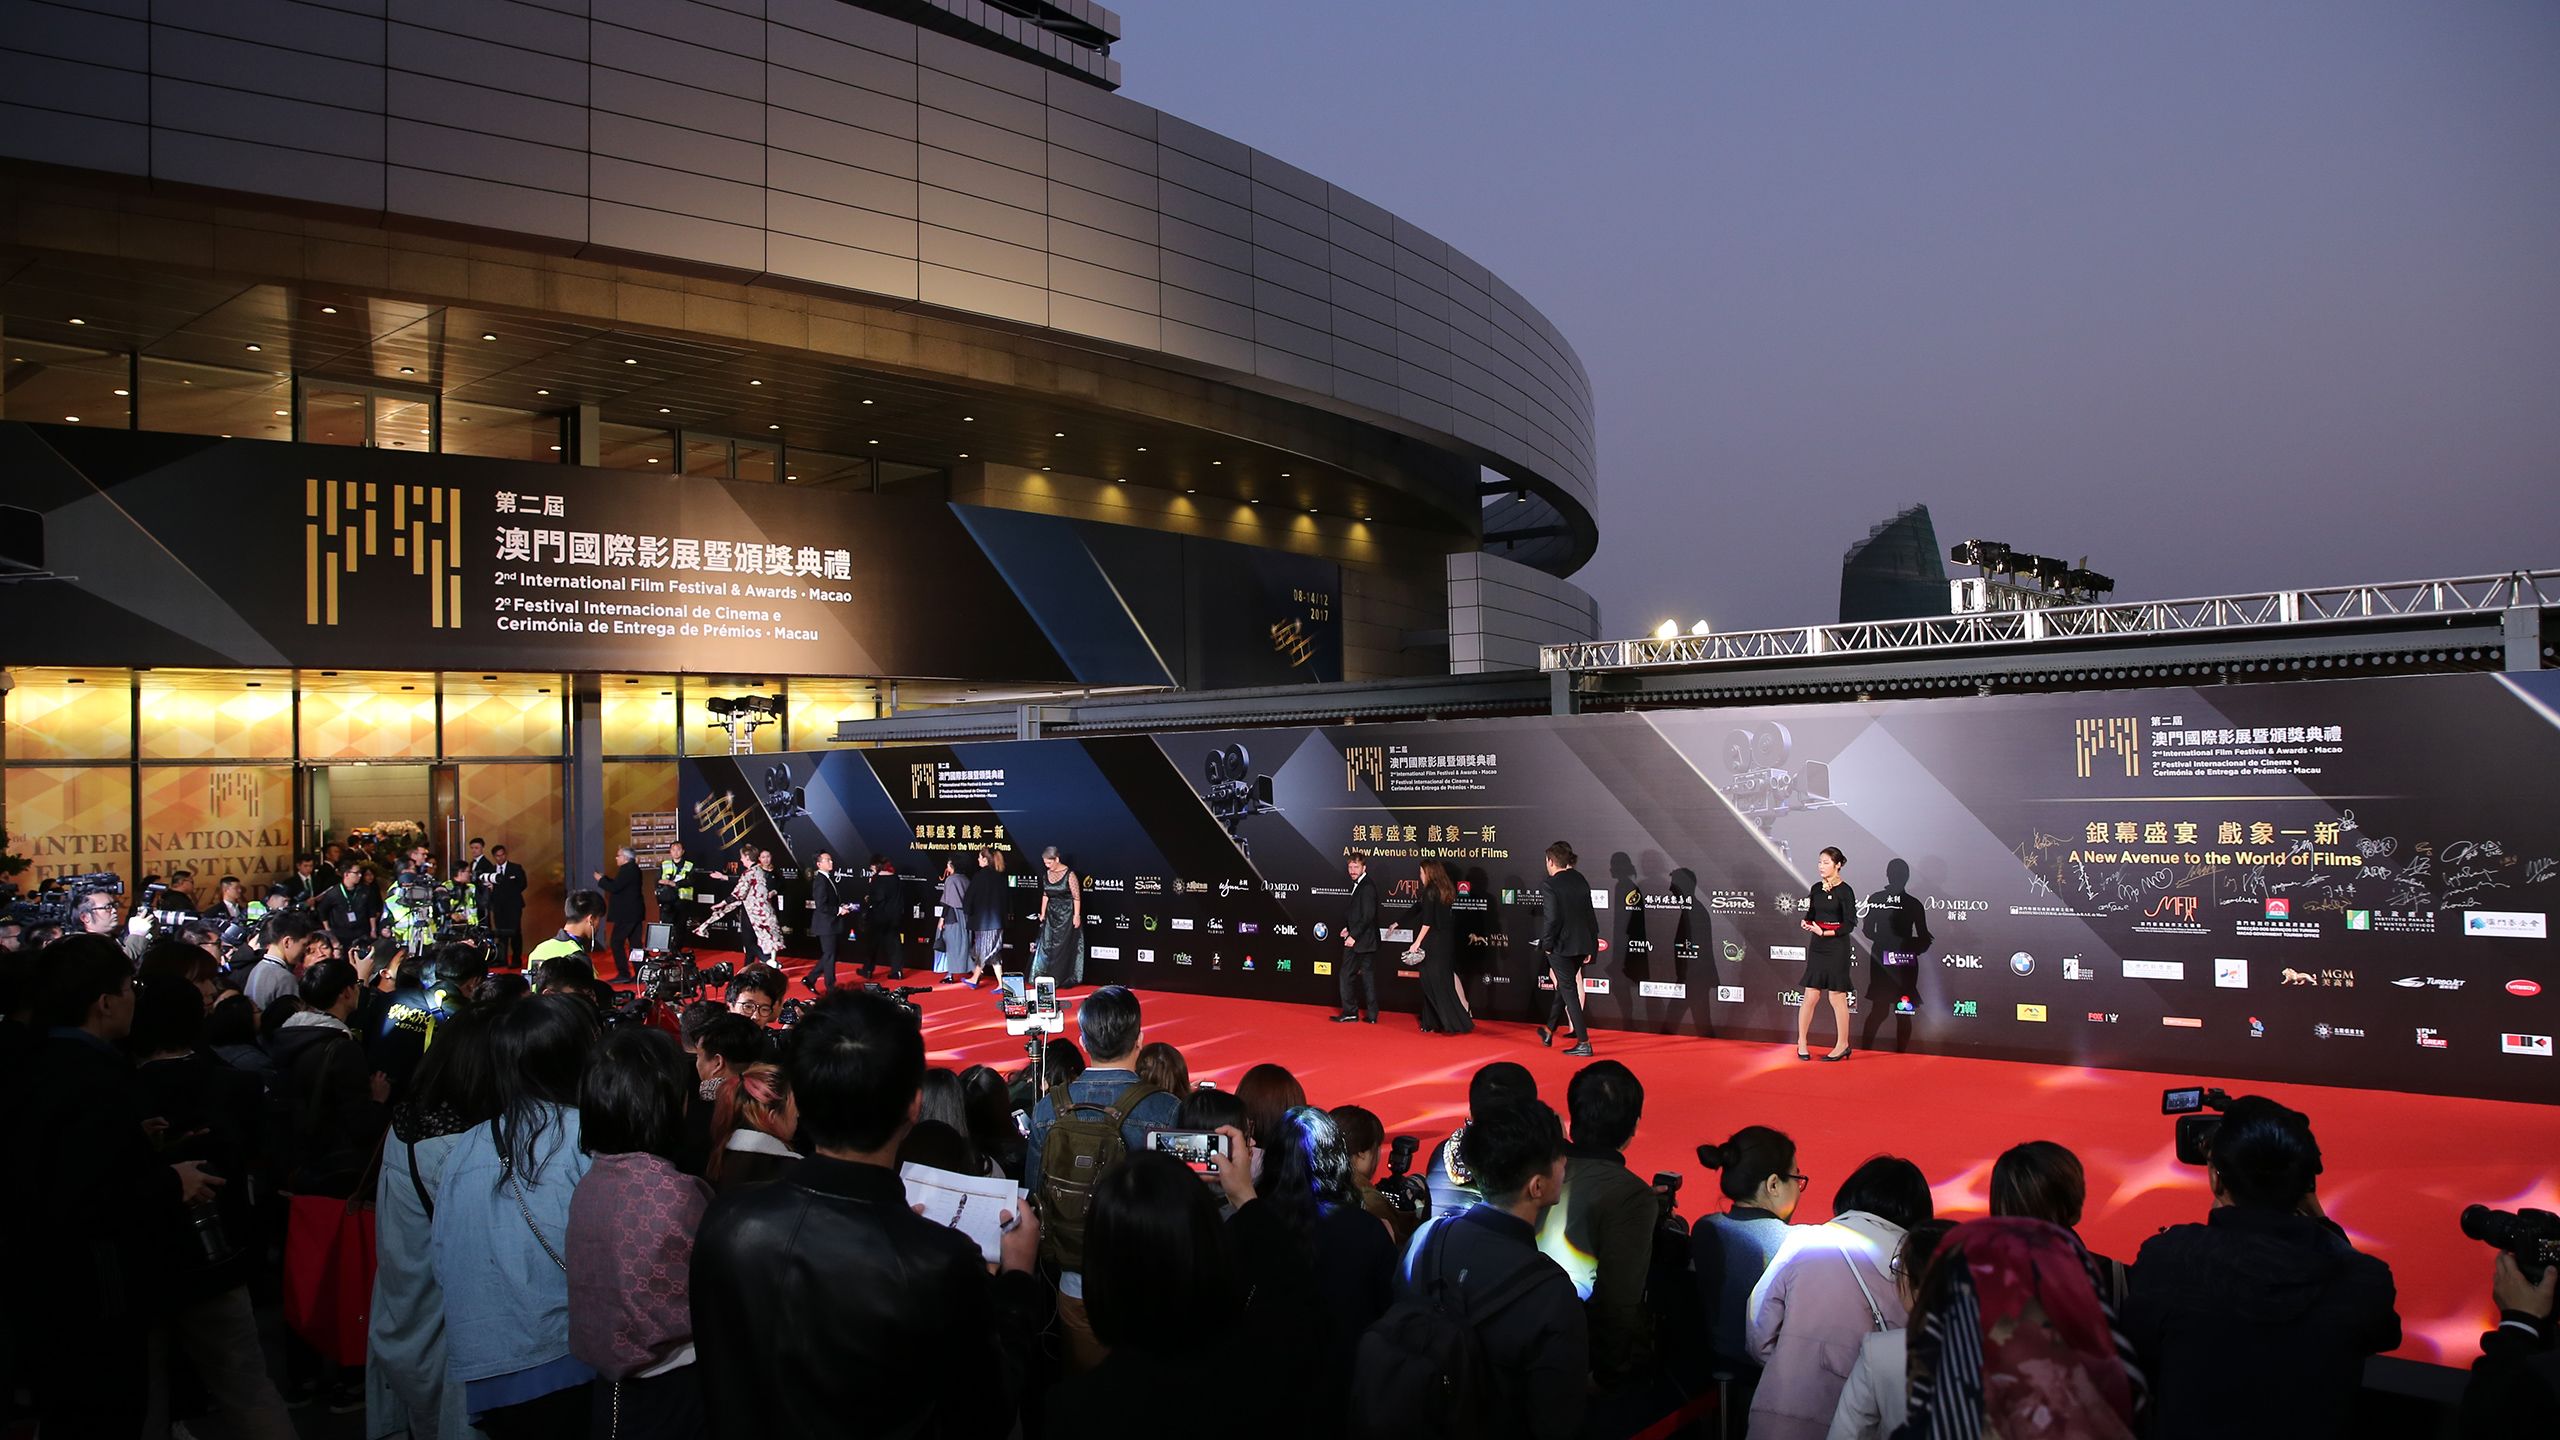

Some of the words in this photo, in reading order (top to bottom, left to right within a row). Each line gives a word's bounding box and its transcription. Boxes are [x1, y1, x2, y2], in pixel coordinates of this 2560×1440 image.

[495, 491, 565, 517] 第二屆
[495, 526, 852, 580] 澳門國際影展暨頒獎典禮
[495, 572, 517, 585] 2nd
[520, 573, 626, 590] International
[631, 578, 664, 592] Film
[669, 580, 727, 596] Festival
[731, 584, 741, 596] &
[745, 585, 798, 599] Awards
[809, 588, 852, 602] Macao
[1293, 588, 1329, 606] 08-14/12
[514, 598, 579, 614] Festival
[584, 601, 688, 619] Internacional
[692, 605, 711, 618] de
[715, 607, 769, 621] Cinema
[773, 611, 782, 621] e
[1310, 608, 1329, 621] 2017
[497, 616, 584, 633] Cerimónia
[588, 619, 609, 633] de
[613, 620, 676, 637] Entrega
[680, 622, 699, 636] de
[703, 623, 762, 638] Prémios
[775, 627, 819, 640] Macau
[2151, 715, 2183, 726] 第二屆
[2152, 725, 2342, 747] 澳門國際影展暨頒獎典禮
[2163, 749, 2213, 757] International
[1353, 825, 1417, 842] 銀幕盛宴
[1427, 825, 1496, 843] 戲象一新
[2085, 821, 2198, 845] 銀幕盛宴
[2217, 821, 2340, 845] 戲象一新
[957, 842, 967, 851] the
[1343, 847, 1350, 856] A
[1373, 847, 1407, 857] Avenue
[1409, 847, 1419, 857] to
[1420, 847, 1436, 857] the
[1437, 847, 1467, 858] World
[1469, 847, 1480, 857] of
[1481, 847, 1508, 858] Films
[2069, 850, 2080, 863] A
[2084, 850, 2117, 863] New
[2120, 850, 2180, 864] Avenue
[2184, 851, 2201, 864] to
[2204, 851, 2232, 865] the
[2235, 851, 2286, 865] World
[2291, 851, 2309, 865] of
[2313, 852, 2362, 866] Films
[145, 854, 291, 879] FESTIVAL
[1274, 883, 1300, 891] MELCO
[1711, 896, 1755, 909] Sands
[1946, 900, 1989, 911] MELCO
[1629, 940, 1644, 948] CTM
[2321, 968, 2355, 980] MGM
[1953, 1000, 1977, 1014] 力報
[2421, 1027, 2437, 1035] FILM
